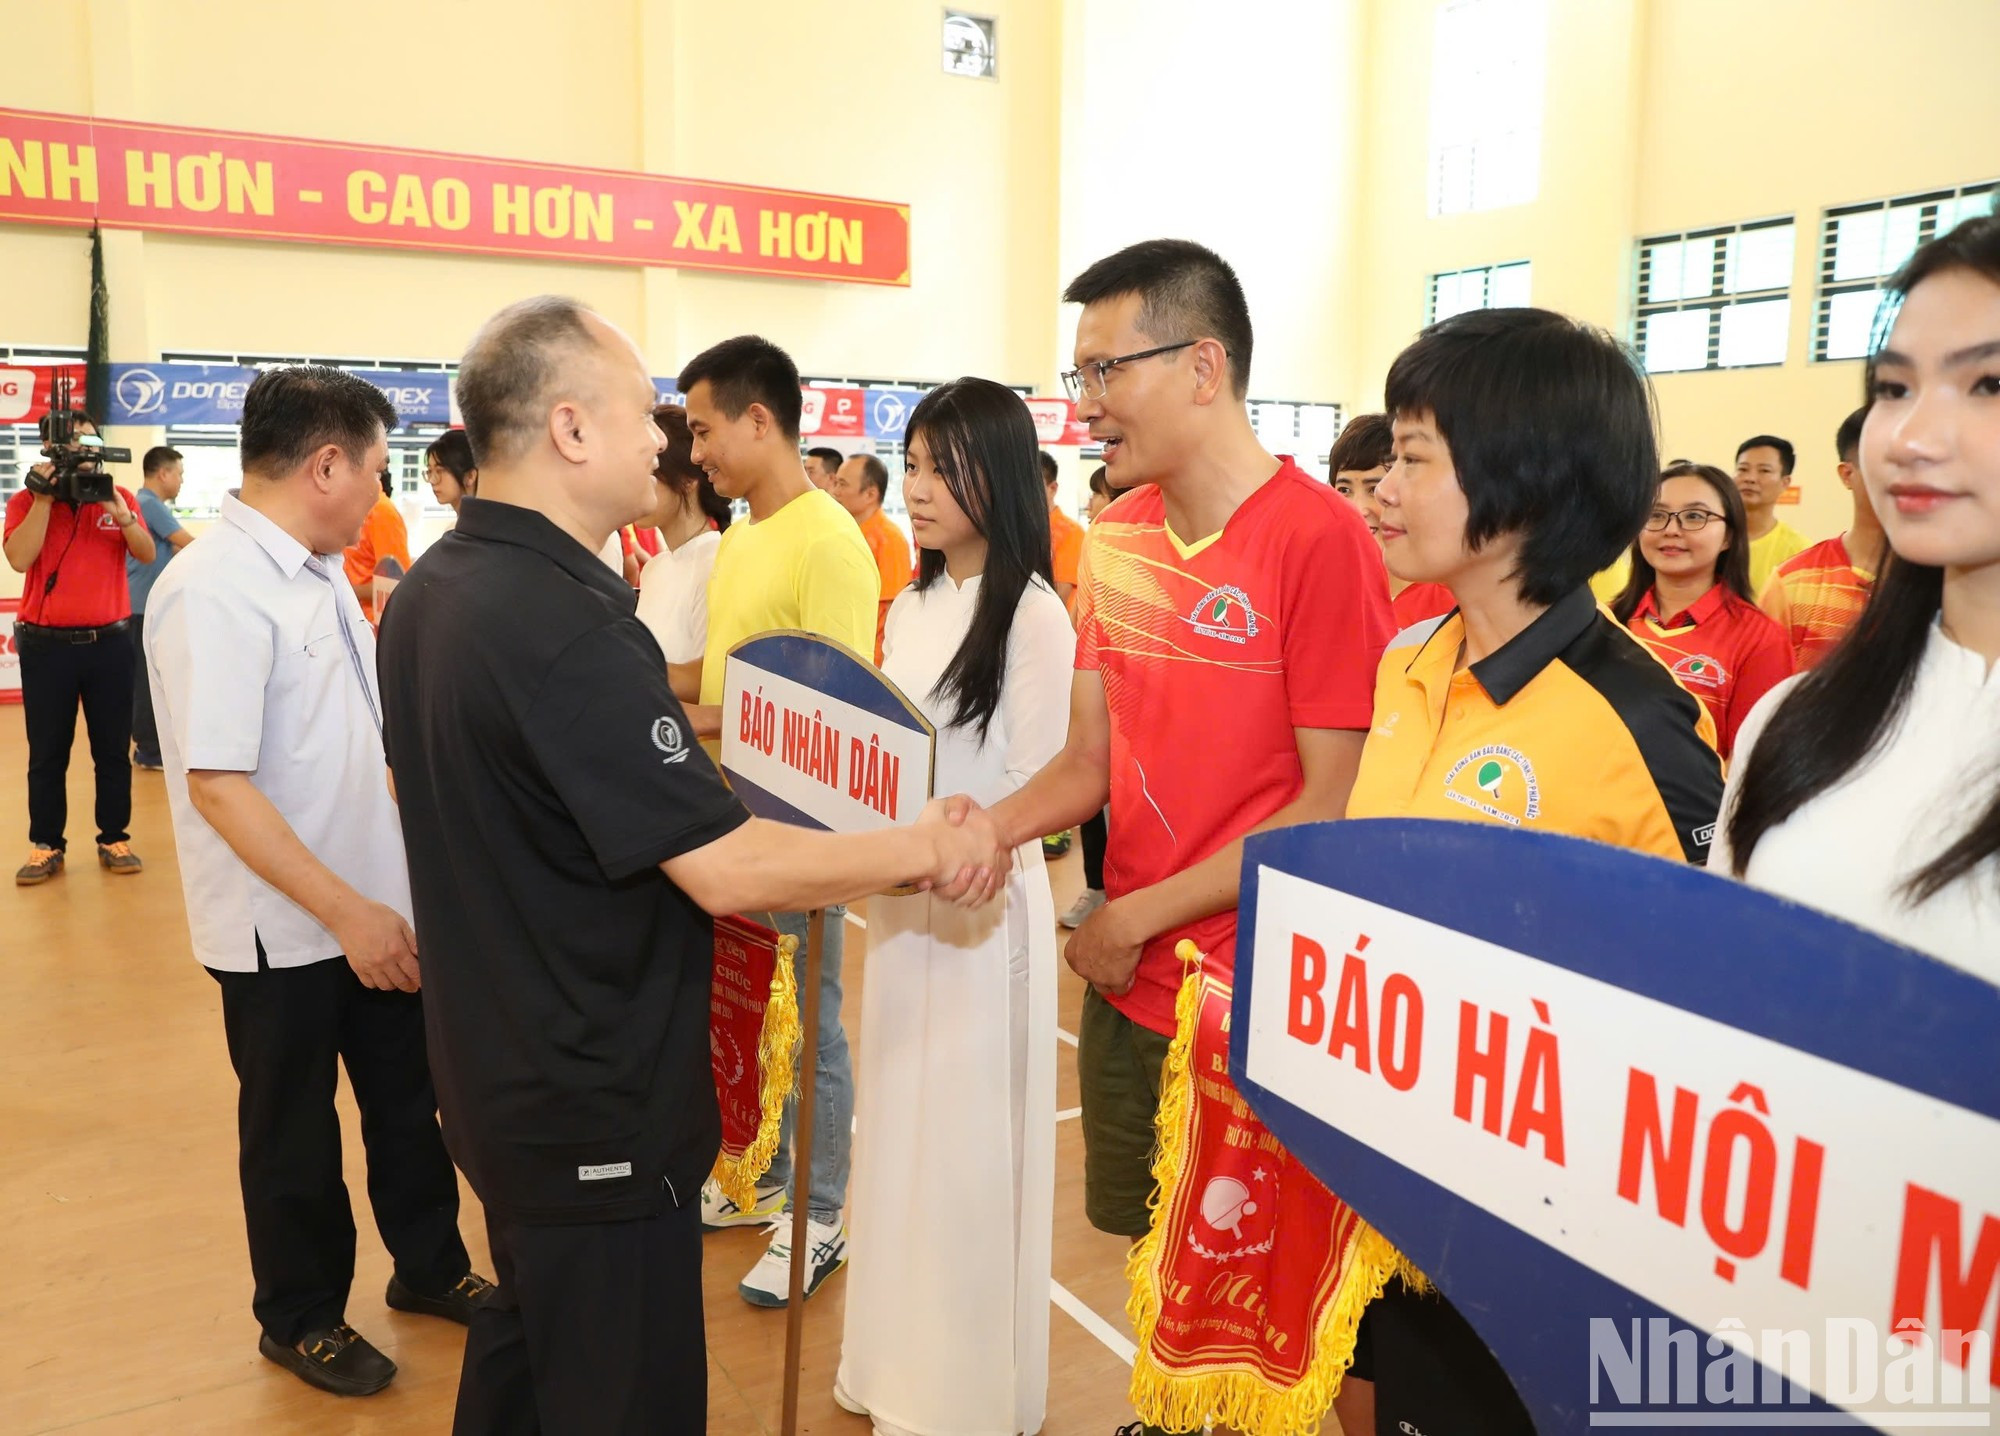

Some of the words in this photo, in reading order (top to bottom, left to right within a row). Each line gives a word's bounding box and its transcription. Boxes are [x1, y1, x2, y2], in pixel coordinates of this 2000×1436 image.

[125, 149, 275, 217] HƠN
[346, 170, 471, 231] CAO
[492, 183, 614, 243] HƠN
[672, 200, 743, 254] XA
[759, 208, 864, 265] HƠN
[739, 686, 776, 757] BÁO
[781, 709, 840, 790] NHÂN
[849, 733, 900, 821] DÂN
[1287, 932, 1424, 1092] BÁO
[1453, 997, 1566, 1169] HÀ
[1616, 1066, 1826, 1291] NỘI
